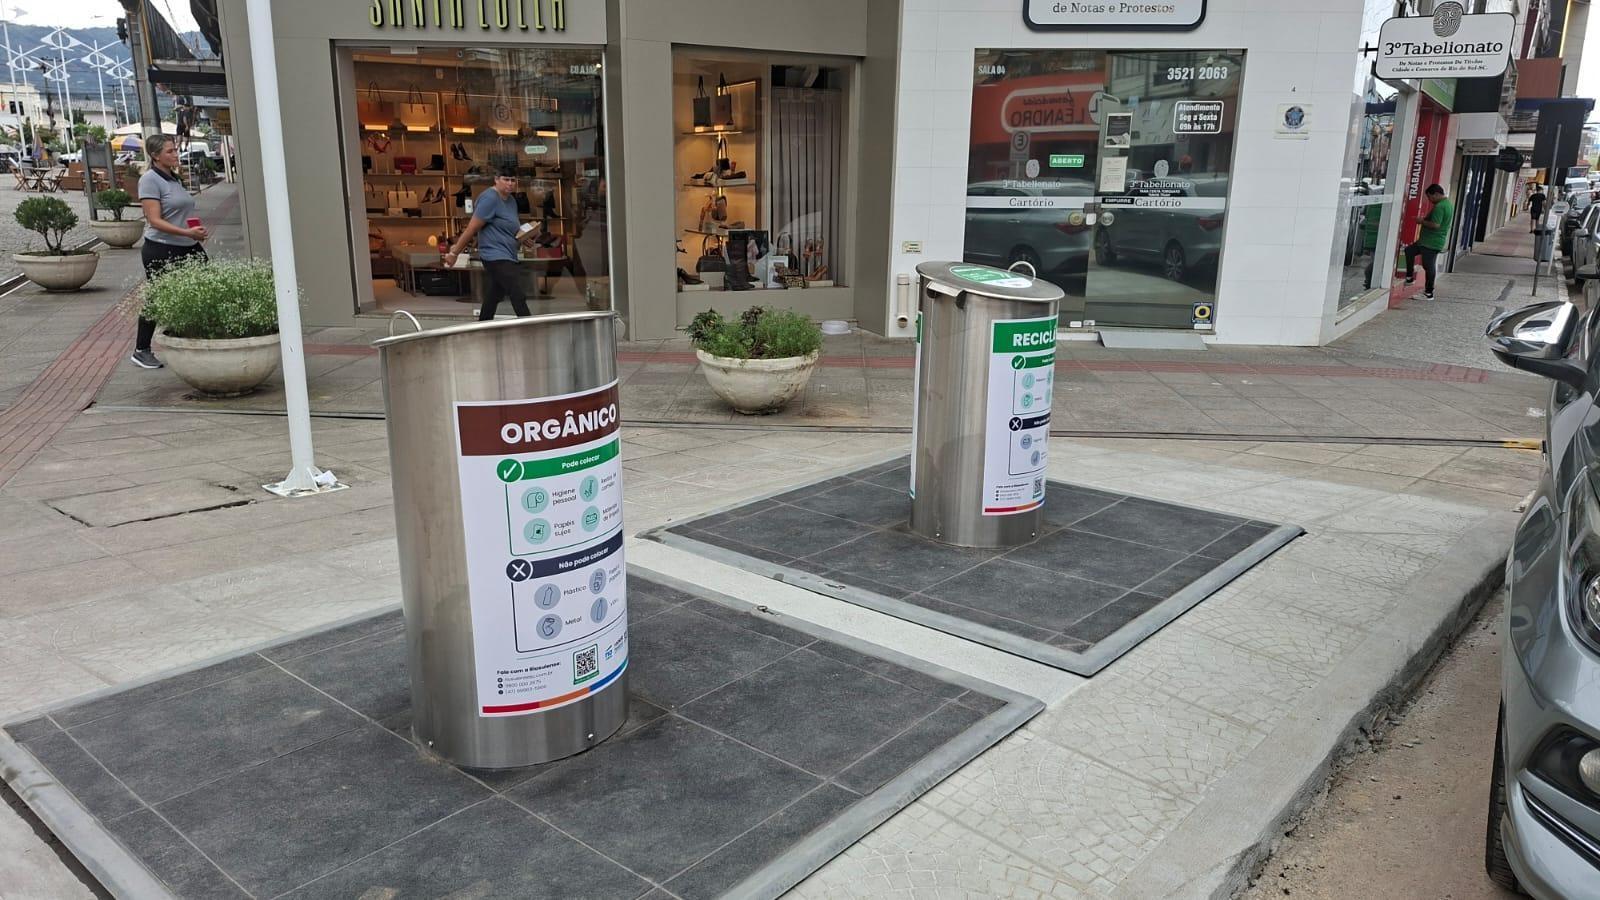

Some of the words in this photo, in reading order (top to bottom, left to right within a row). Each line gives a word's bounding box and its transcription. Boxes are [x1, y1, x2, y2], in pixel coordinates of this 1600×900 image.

[1052, 3, 1067, 13] de
[1070, 3, 1105, 13] Notas
[1120, 4, 1175, 14] Protestos
[978, 65, 996, 74] SALA
[997, 65, 1005, 74] 04
[1167, 67, 1194, 80] 3521
[1198, 66, 1228, 79] 2063
[1180, 114, 1192, 122] Seg
[1409, 136, 1426, 200] TRABALHADOR
[1011, 180, 1061, 188] Tabelionato
[1140, 180, 1190, 188] Tabelionato
[1009, 198, 1054, 207] Cartório
[1135, 198, 1182, 207] Cartório
[501, 403, 617, 444] ORGÂNICO
[580, 454, 600, 465] colocar
[552, 488, 575, 498] Higiene
[552, 495, 576, 506] pessoal
[554, 520, 575, 529] Papéis
[559, 561, 573, 569] Não
[574, 556, 590, 567] pode
[564, 585, 587, 596] Plástico
[565, 616, 582, 625] Metal
